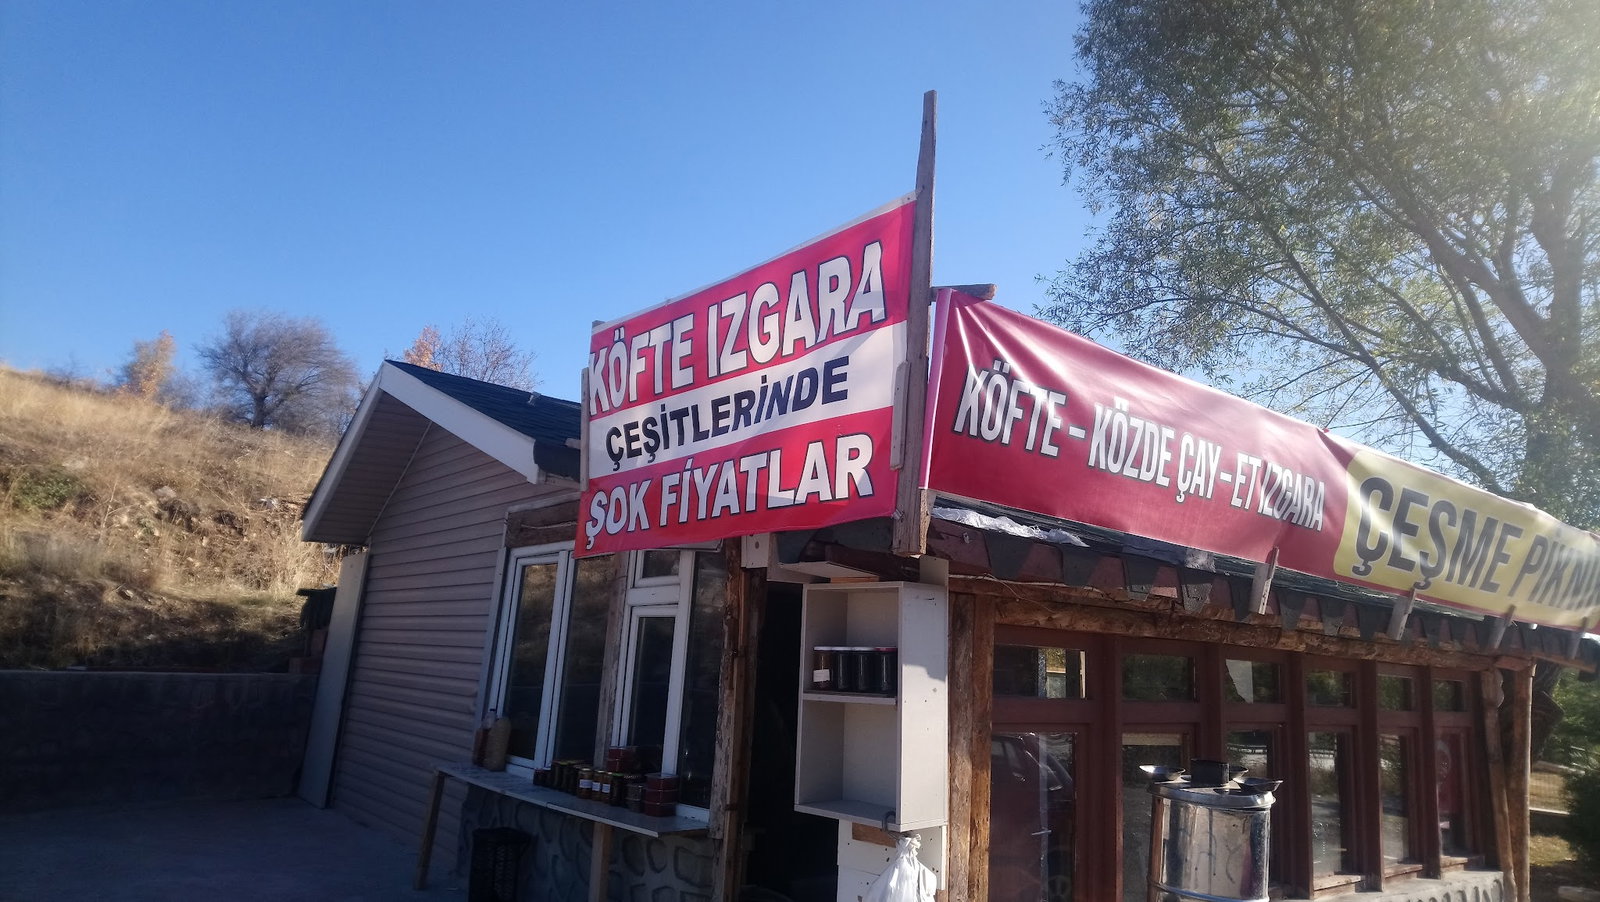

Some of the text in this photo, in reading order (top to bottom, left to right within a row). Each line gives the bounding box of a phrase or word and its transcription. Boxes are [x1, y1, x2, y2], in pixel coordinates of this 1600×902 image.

[589, 240, 886, 416] KÖFTE IZGARA
[605, 356, 849, 471] ÇEŞİTLERİNDE
[953, 360, 1066, 458] KÖFTE
[1088, 396, 1176, 488] KÖZDE
[1175, 431, 1222, 503] ÇAY
[1230, 452, 1262, 510] ET
[1257, 460, 1326, 533] IZGARA
[585, 433, 873, 549] ŞOK FİYATLAR
[1351, 476, 1523, 593] ÇEŞME
